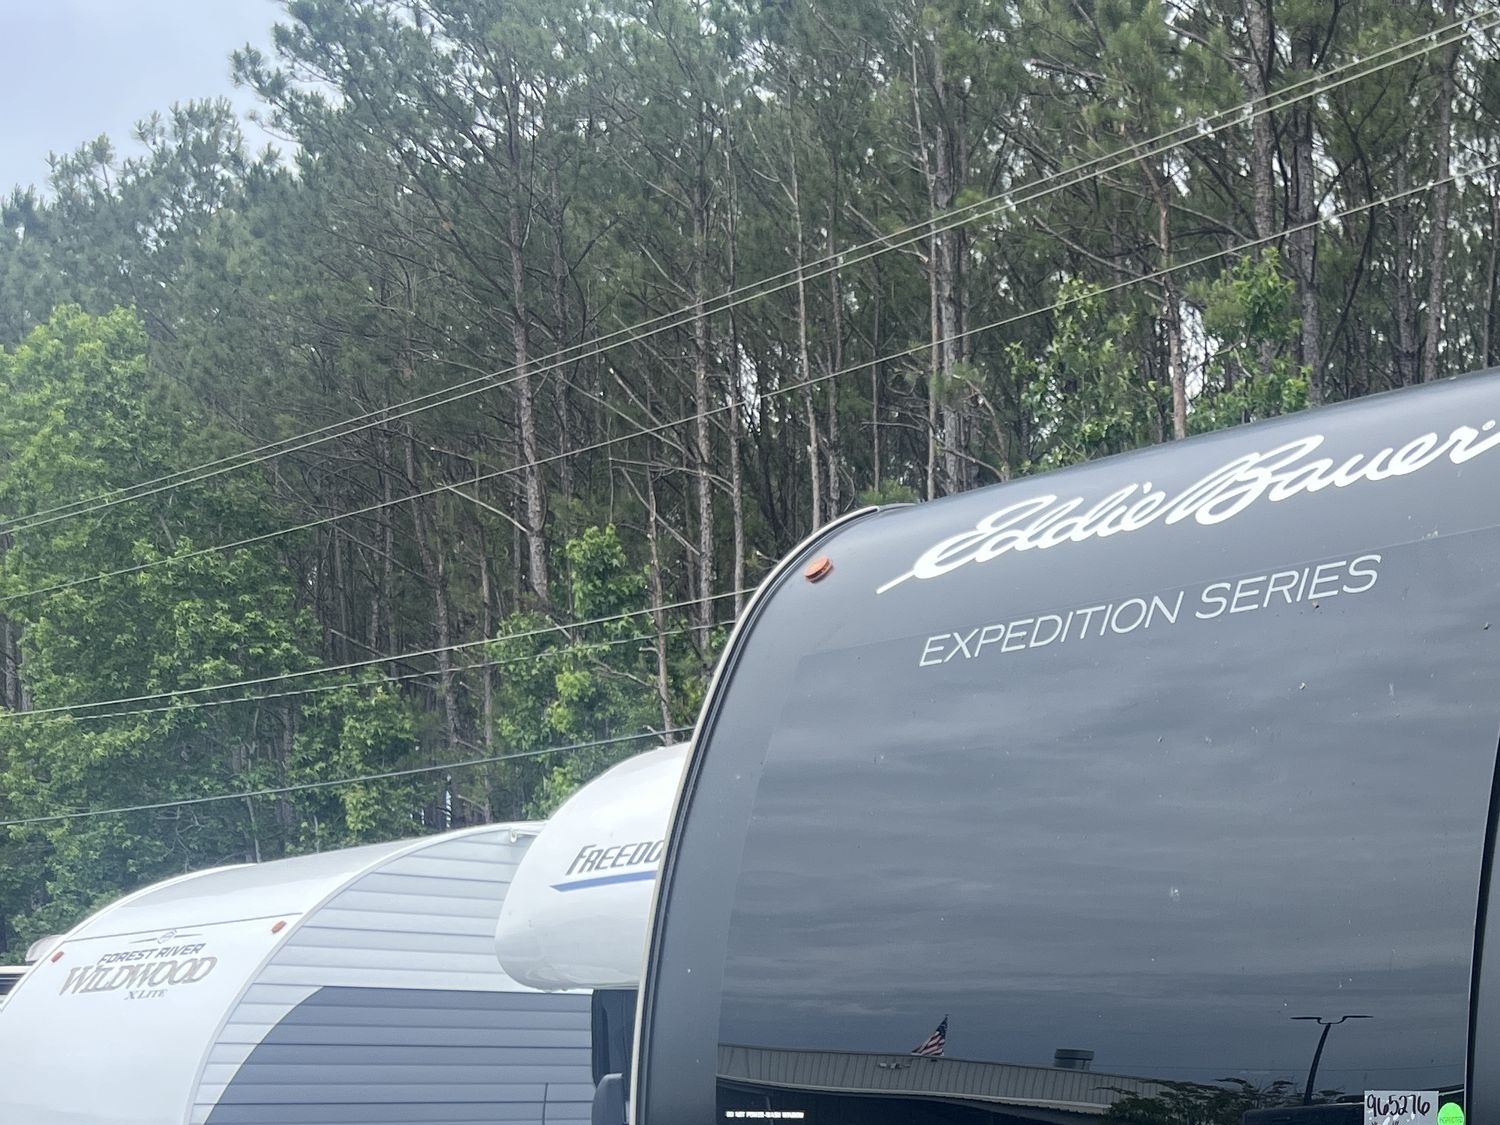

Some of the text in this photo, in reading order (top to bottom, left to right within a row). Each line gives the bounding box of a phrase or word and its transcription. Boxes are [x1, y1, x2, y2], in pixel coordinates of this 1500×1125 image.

[876, 482, 1164, 595] Eddie
[918, 554, 1383, 668] EXPEDITION SERIES
[98, 942, 206, 964] FOREST RIVER
[58, 955, 218, 997] WILDWOOD
[1366, 1094, 1431, 1118] 965276
